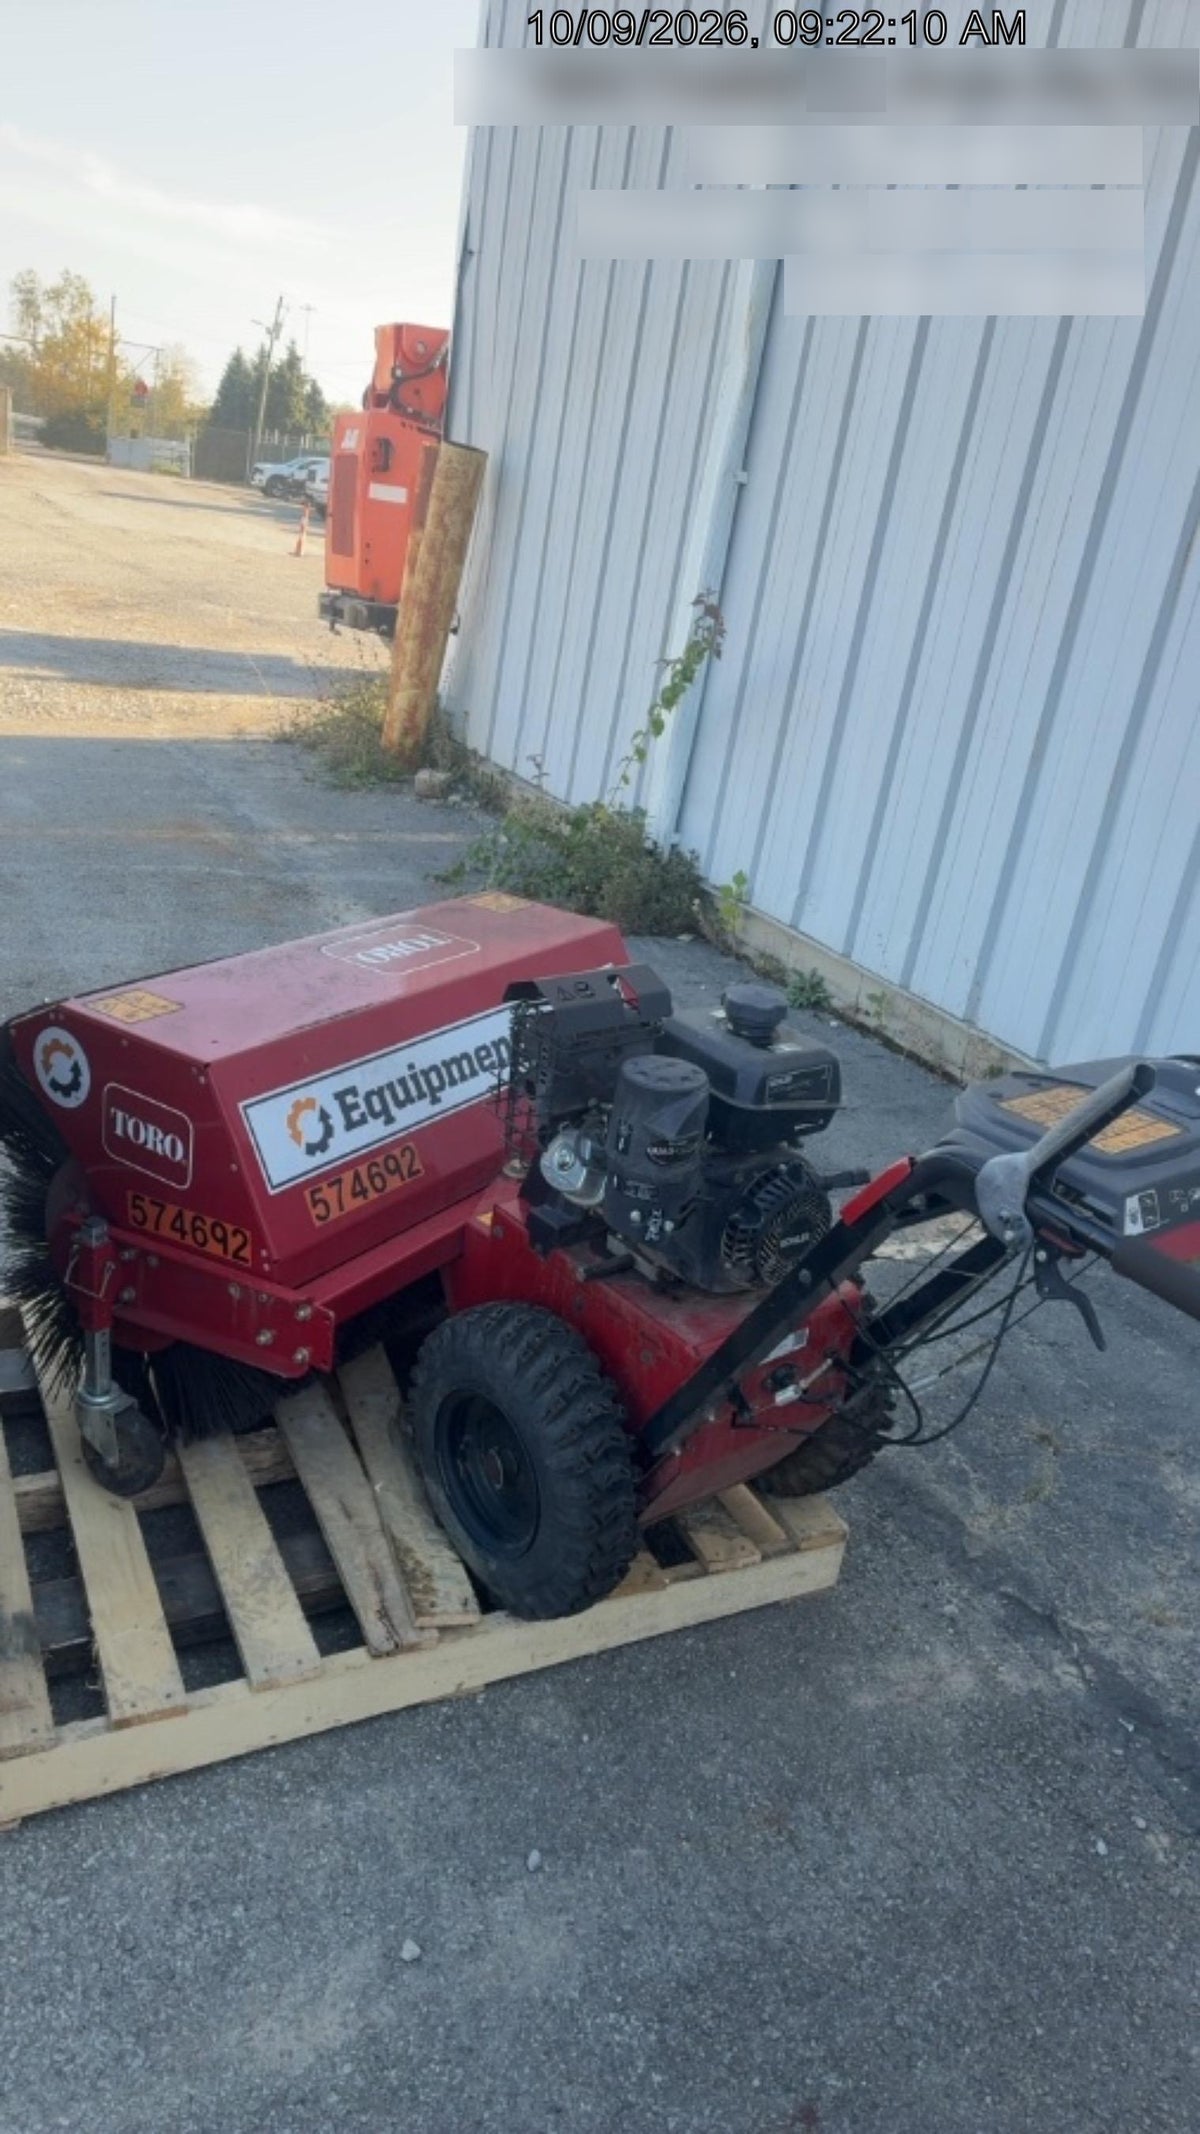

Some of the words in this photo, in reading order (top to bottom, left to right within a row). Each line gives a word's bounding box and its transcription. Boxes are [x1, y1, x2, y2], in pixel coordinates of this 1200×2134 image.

[355, 933, 452, 964] TORO
[333, 1035, 513, 1132] Equipmen
[110, 1106, 185, 1162] TORO
[310, 1144, 422, 1222] 574692
[130, 1194, 250, 1263] 574692
